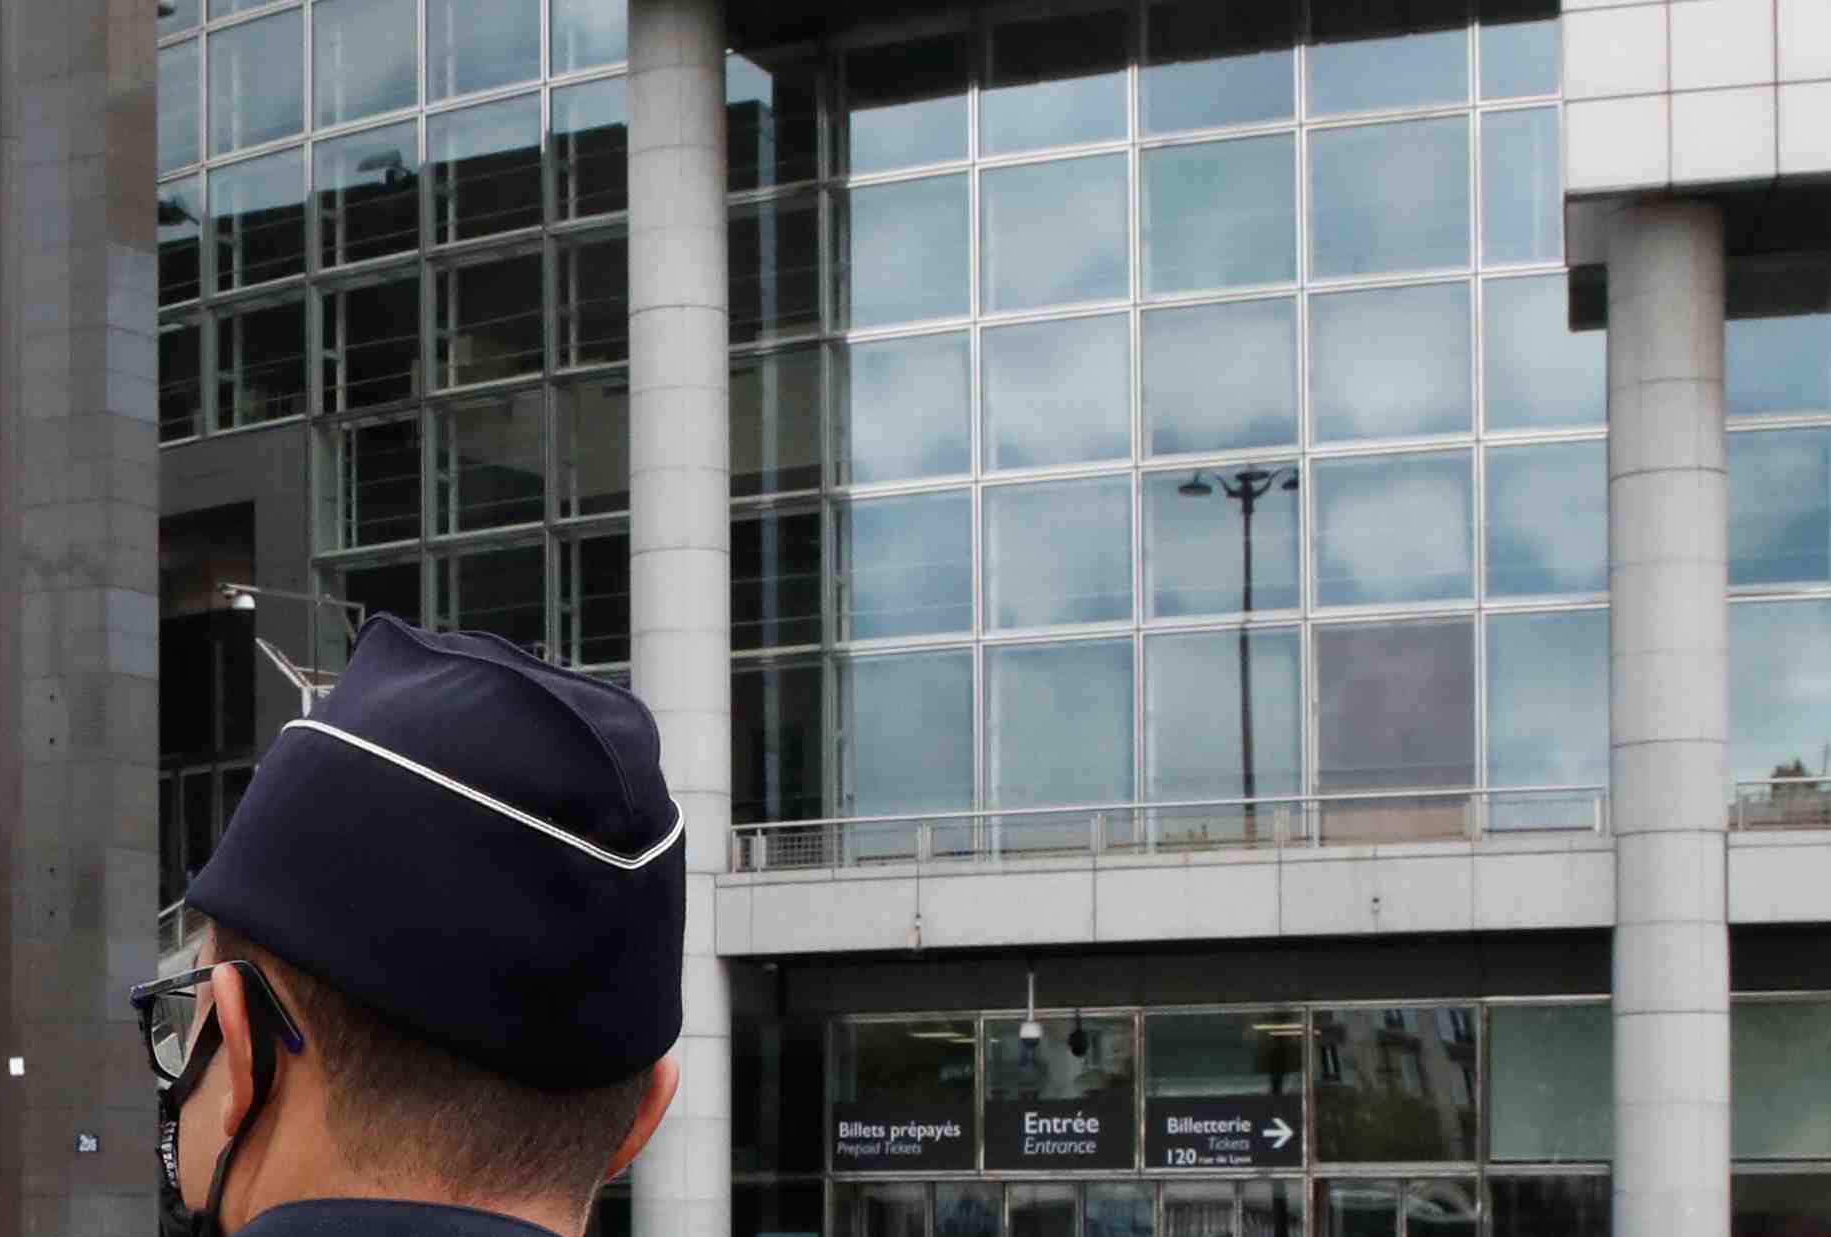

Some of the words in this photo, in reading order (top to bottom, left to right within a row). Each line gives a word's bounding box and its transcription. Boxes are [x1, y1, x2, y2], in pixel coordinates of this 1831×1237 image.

[839, 1121, 885, 1139] Billets
[890, 1120, 961, 1142] prépayés
[1024, 1111, 1100, 1135] Entrée
[1166, 1115, 1252, 1135] Billetterie
[837, 1142, 881, 1155] Prepaid
[884, 1140, 922, 1154] Tickets
[1024, 1136, 1098, 1155] Entrance
[1207, 1135, 1251, 1151] Tickets
[1166, 1148, 1197, 1165] 120
